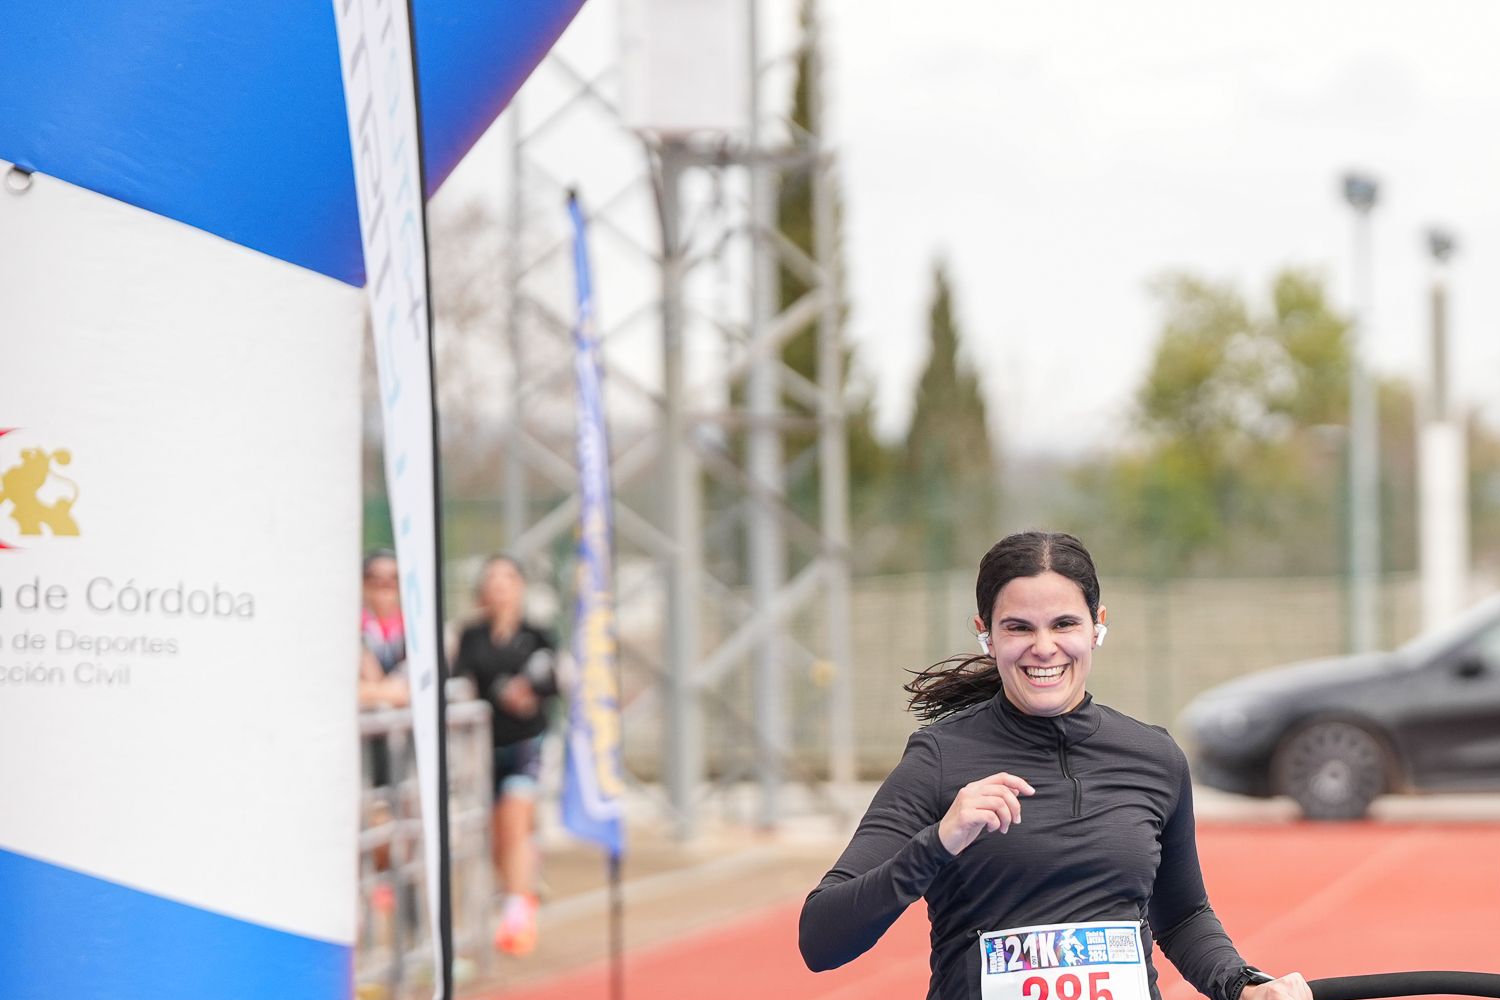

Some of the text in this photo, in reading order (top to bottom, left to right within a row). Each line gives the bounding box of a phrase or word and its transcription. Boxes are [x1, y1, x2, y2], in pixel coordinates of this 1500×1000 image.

[15, 575, 68, 612] de
[86, 576, 255, 618] Córdoba
[12, 629, 46, 651] de
[55, 628, 179, 657] Deportes
[73, 661, 131, 686] Civil
[1005, 932, 1060, 971] 21K
